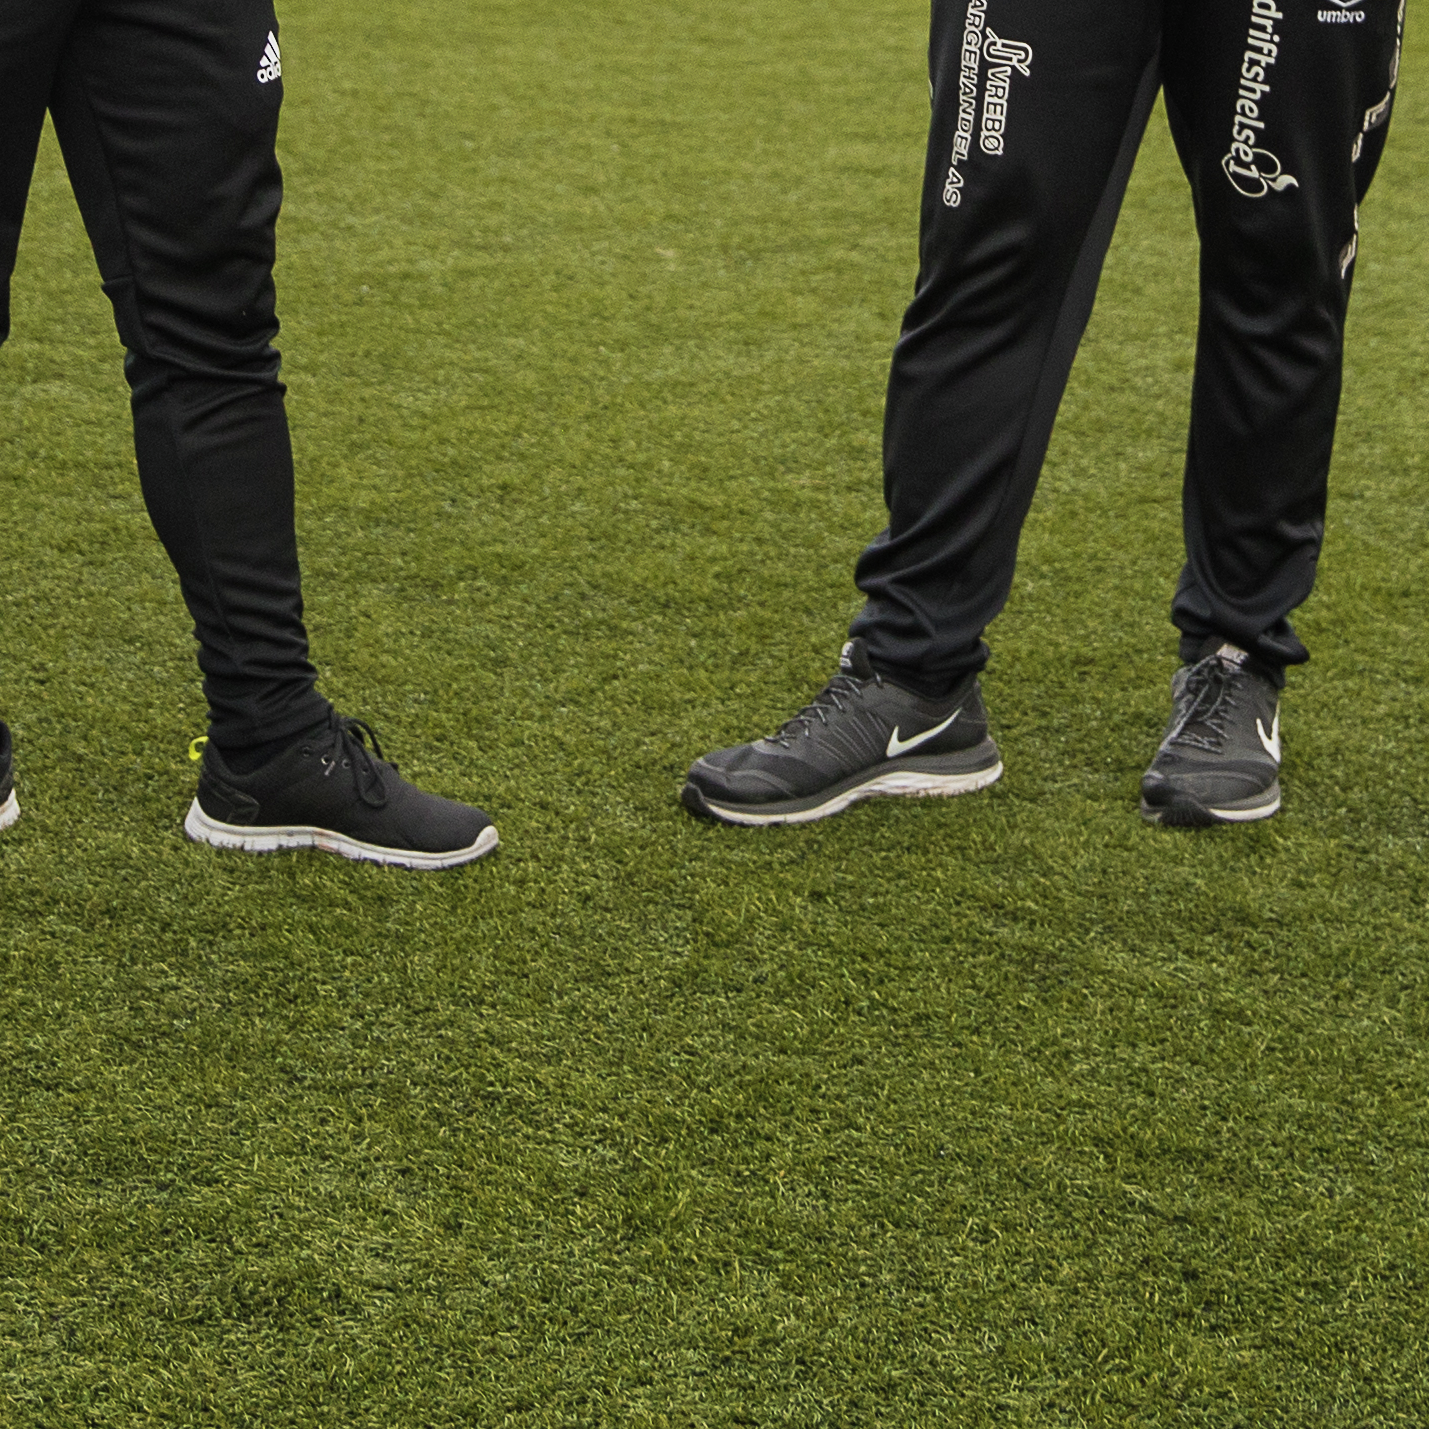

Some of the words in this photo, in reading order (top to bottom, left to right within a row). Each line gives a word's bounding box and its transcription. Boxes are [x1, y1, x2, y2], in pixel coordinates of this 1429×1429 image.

[1317, 9, 1365, 24] umbro
[979, 66, 1011, 156] VREBØ
[943, 166, 964, 207] AS
